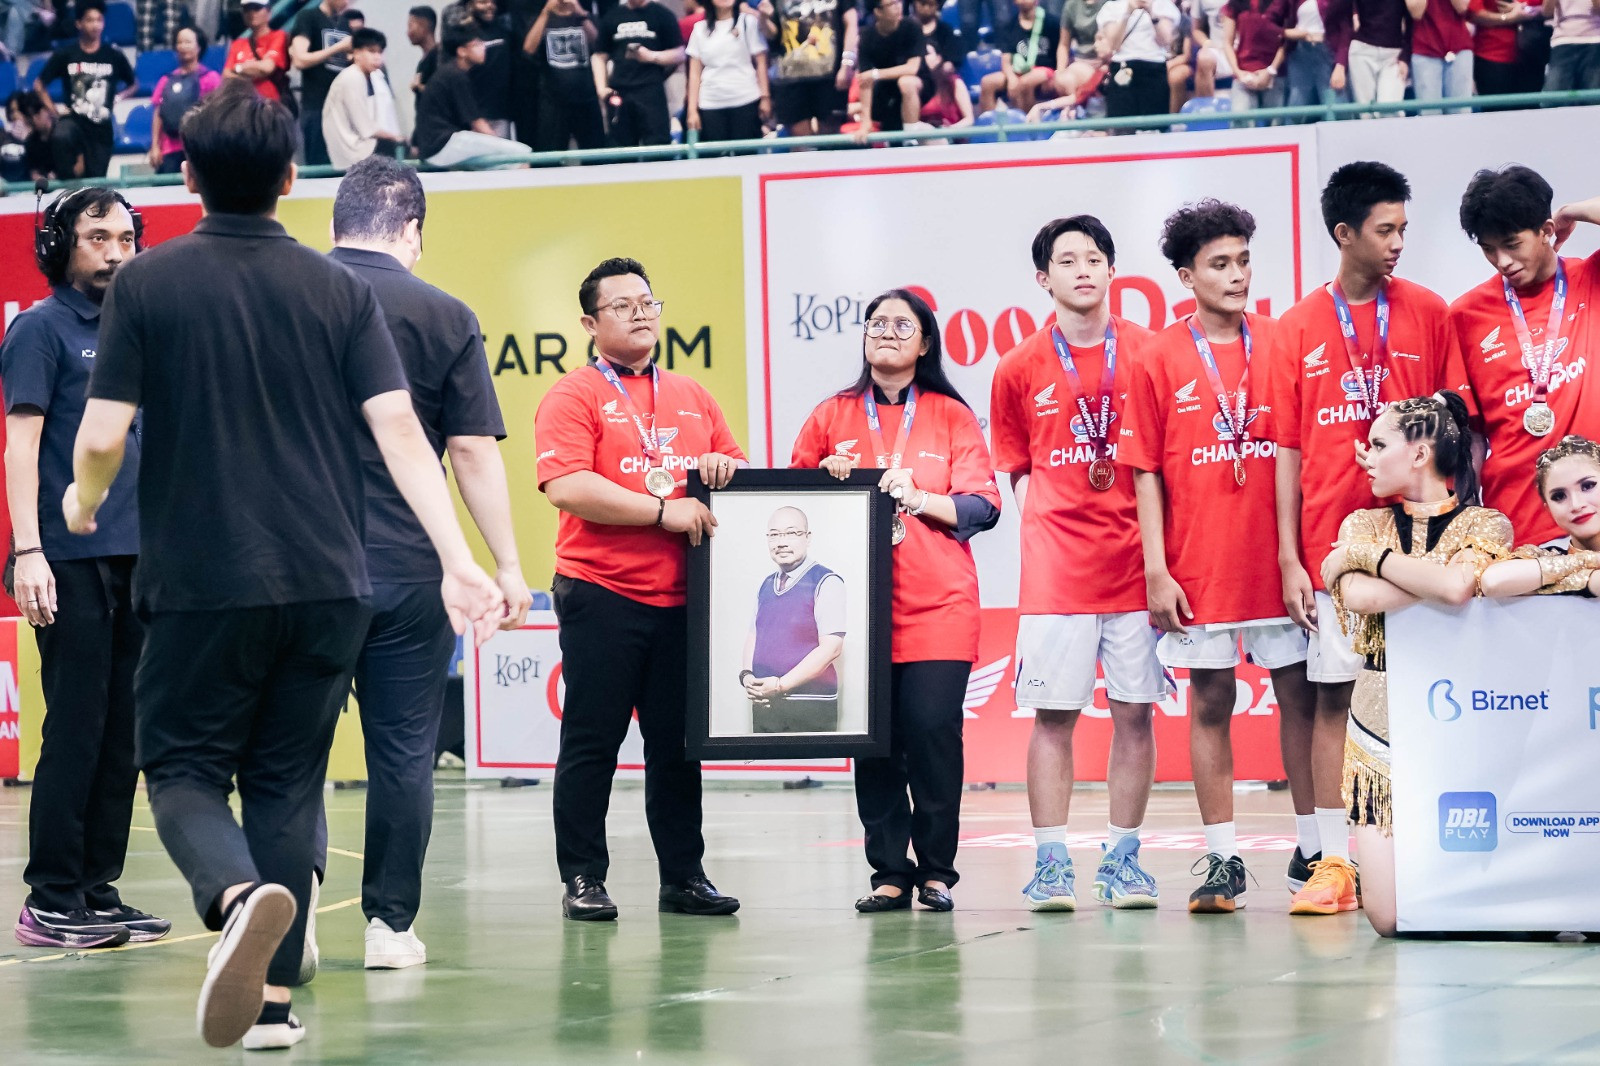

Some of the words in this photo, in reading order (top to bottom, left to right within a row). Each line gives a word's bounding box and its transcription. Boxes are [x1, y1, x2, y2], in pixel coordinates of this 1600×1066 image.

[1098, 395, 1110, 438] CHAMPION
[1471, 690, 1549, 711] Biznet
[1445, 807, 1491, 828] DBL
[1512, 817, 1576, 827] DOWNLOAD
[1578, 817, 1600, 827] APP
[1445, 828, 1489, 839] PLAY
[1543, 828, 1570, 838] NOW
